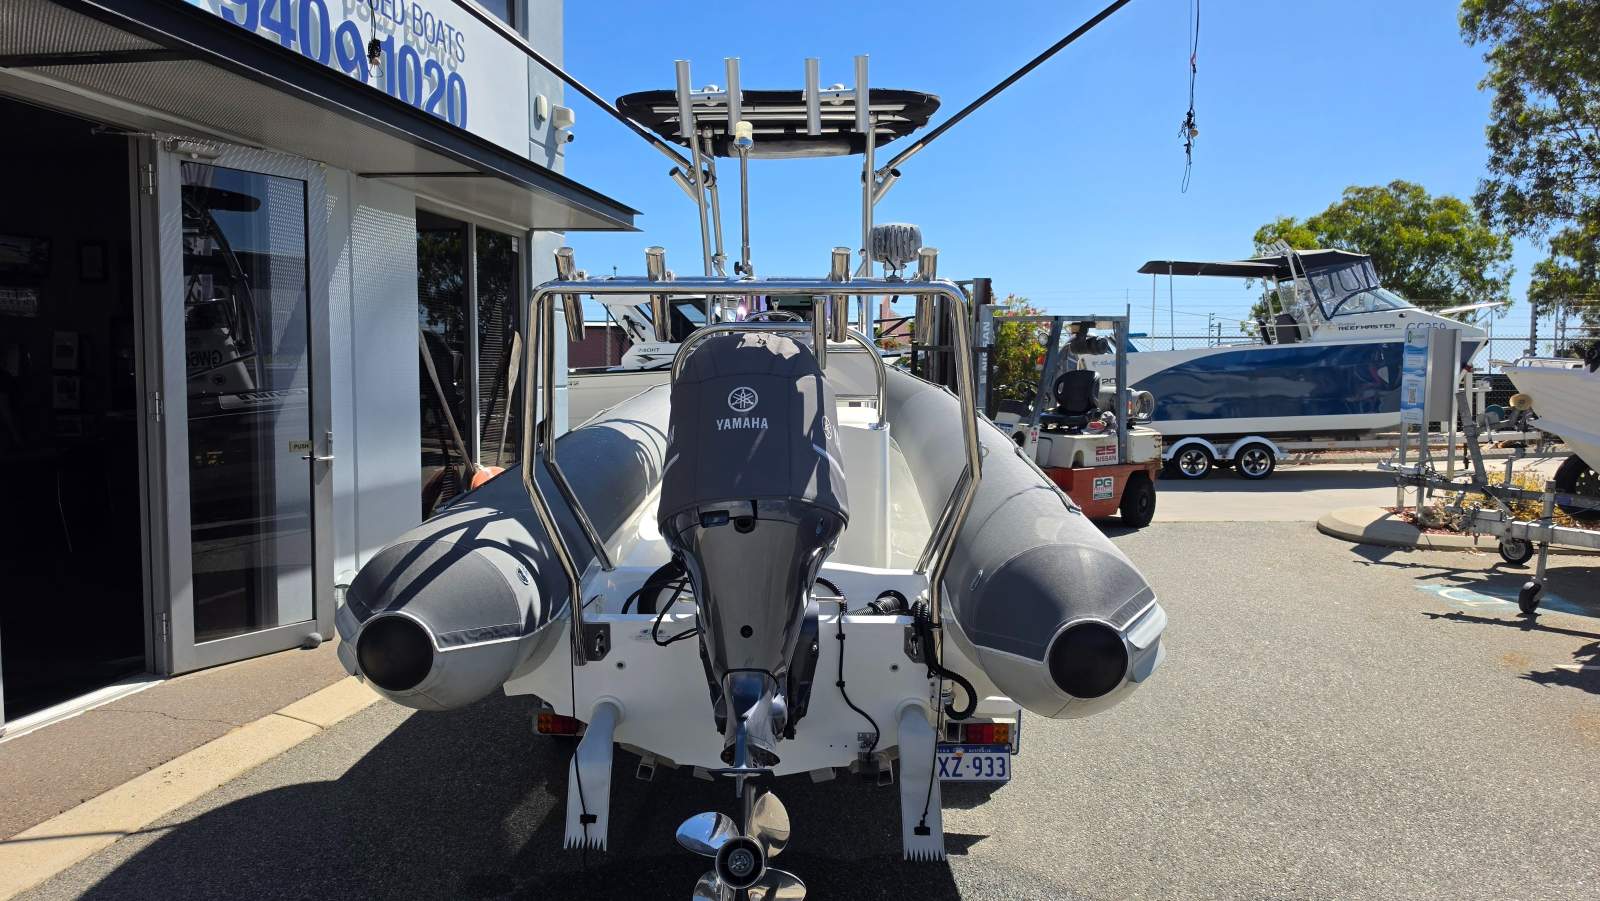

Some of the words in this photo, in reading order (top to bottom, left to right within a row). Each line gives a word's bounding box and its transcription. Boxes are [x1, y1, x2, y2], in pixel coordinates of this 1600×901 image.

[412, 2, 465, 63] BOATS
[379, 34, 468, 130] 1020
[716, 417, 769, 431] YAMAHA
[1095, 445, 1116, 456] 25
[1095, 455, 1117, 463] NISSAN
